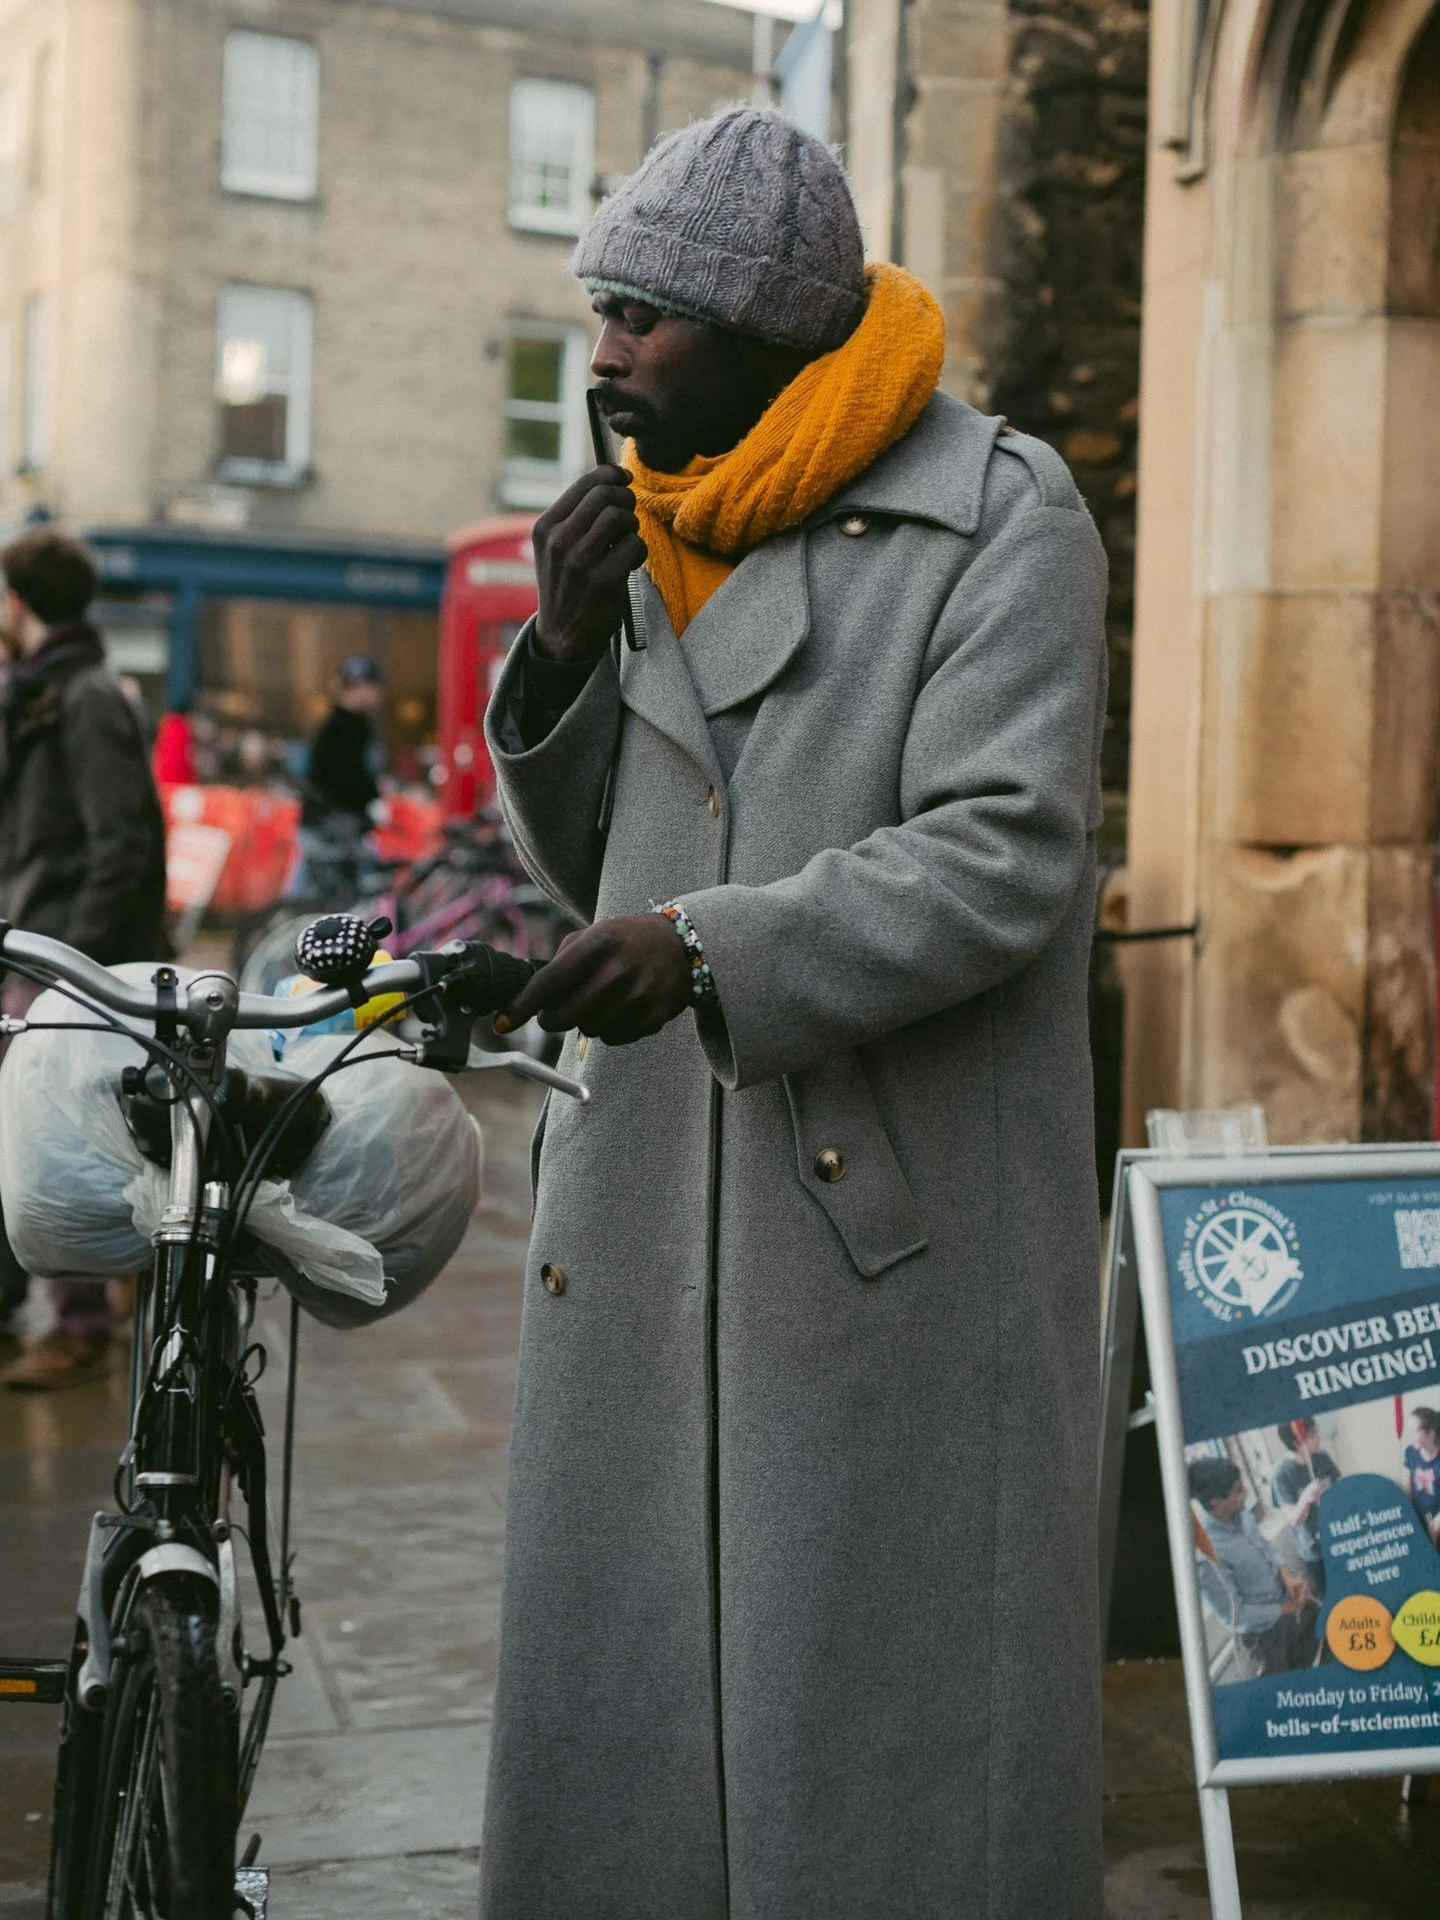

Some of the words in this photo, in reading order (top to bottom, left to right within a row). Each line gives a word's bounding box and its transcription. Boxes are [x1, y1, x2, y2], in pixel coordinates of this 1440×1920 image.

[1184, 1216, 1200, 1240] of
[1200, 1199, 1219, 1217] St
[1241, 1316, 1394, 1375] DISCOVER
[1294, 1336, 1438, 1400] RINGING!
[1328, 1504, 1403, 1538] Half-hour
[1330, 1522, 1414, 1557] experiences
[1347, 1542, 1409, 1572] available
[1365, 1563, 1401, 1586] here
[1339, 1616, 1381, 1632] Adults
[1402, 1611, 1440, 1627] Child
[1349, 1631, 1378, 1652] £8
[1276, 1686, 1346, 1710] Monday
[1348, 1688, 1367, 1705] to
[1369, 1681, 1430, 1705] Friday,
